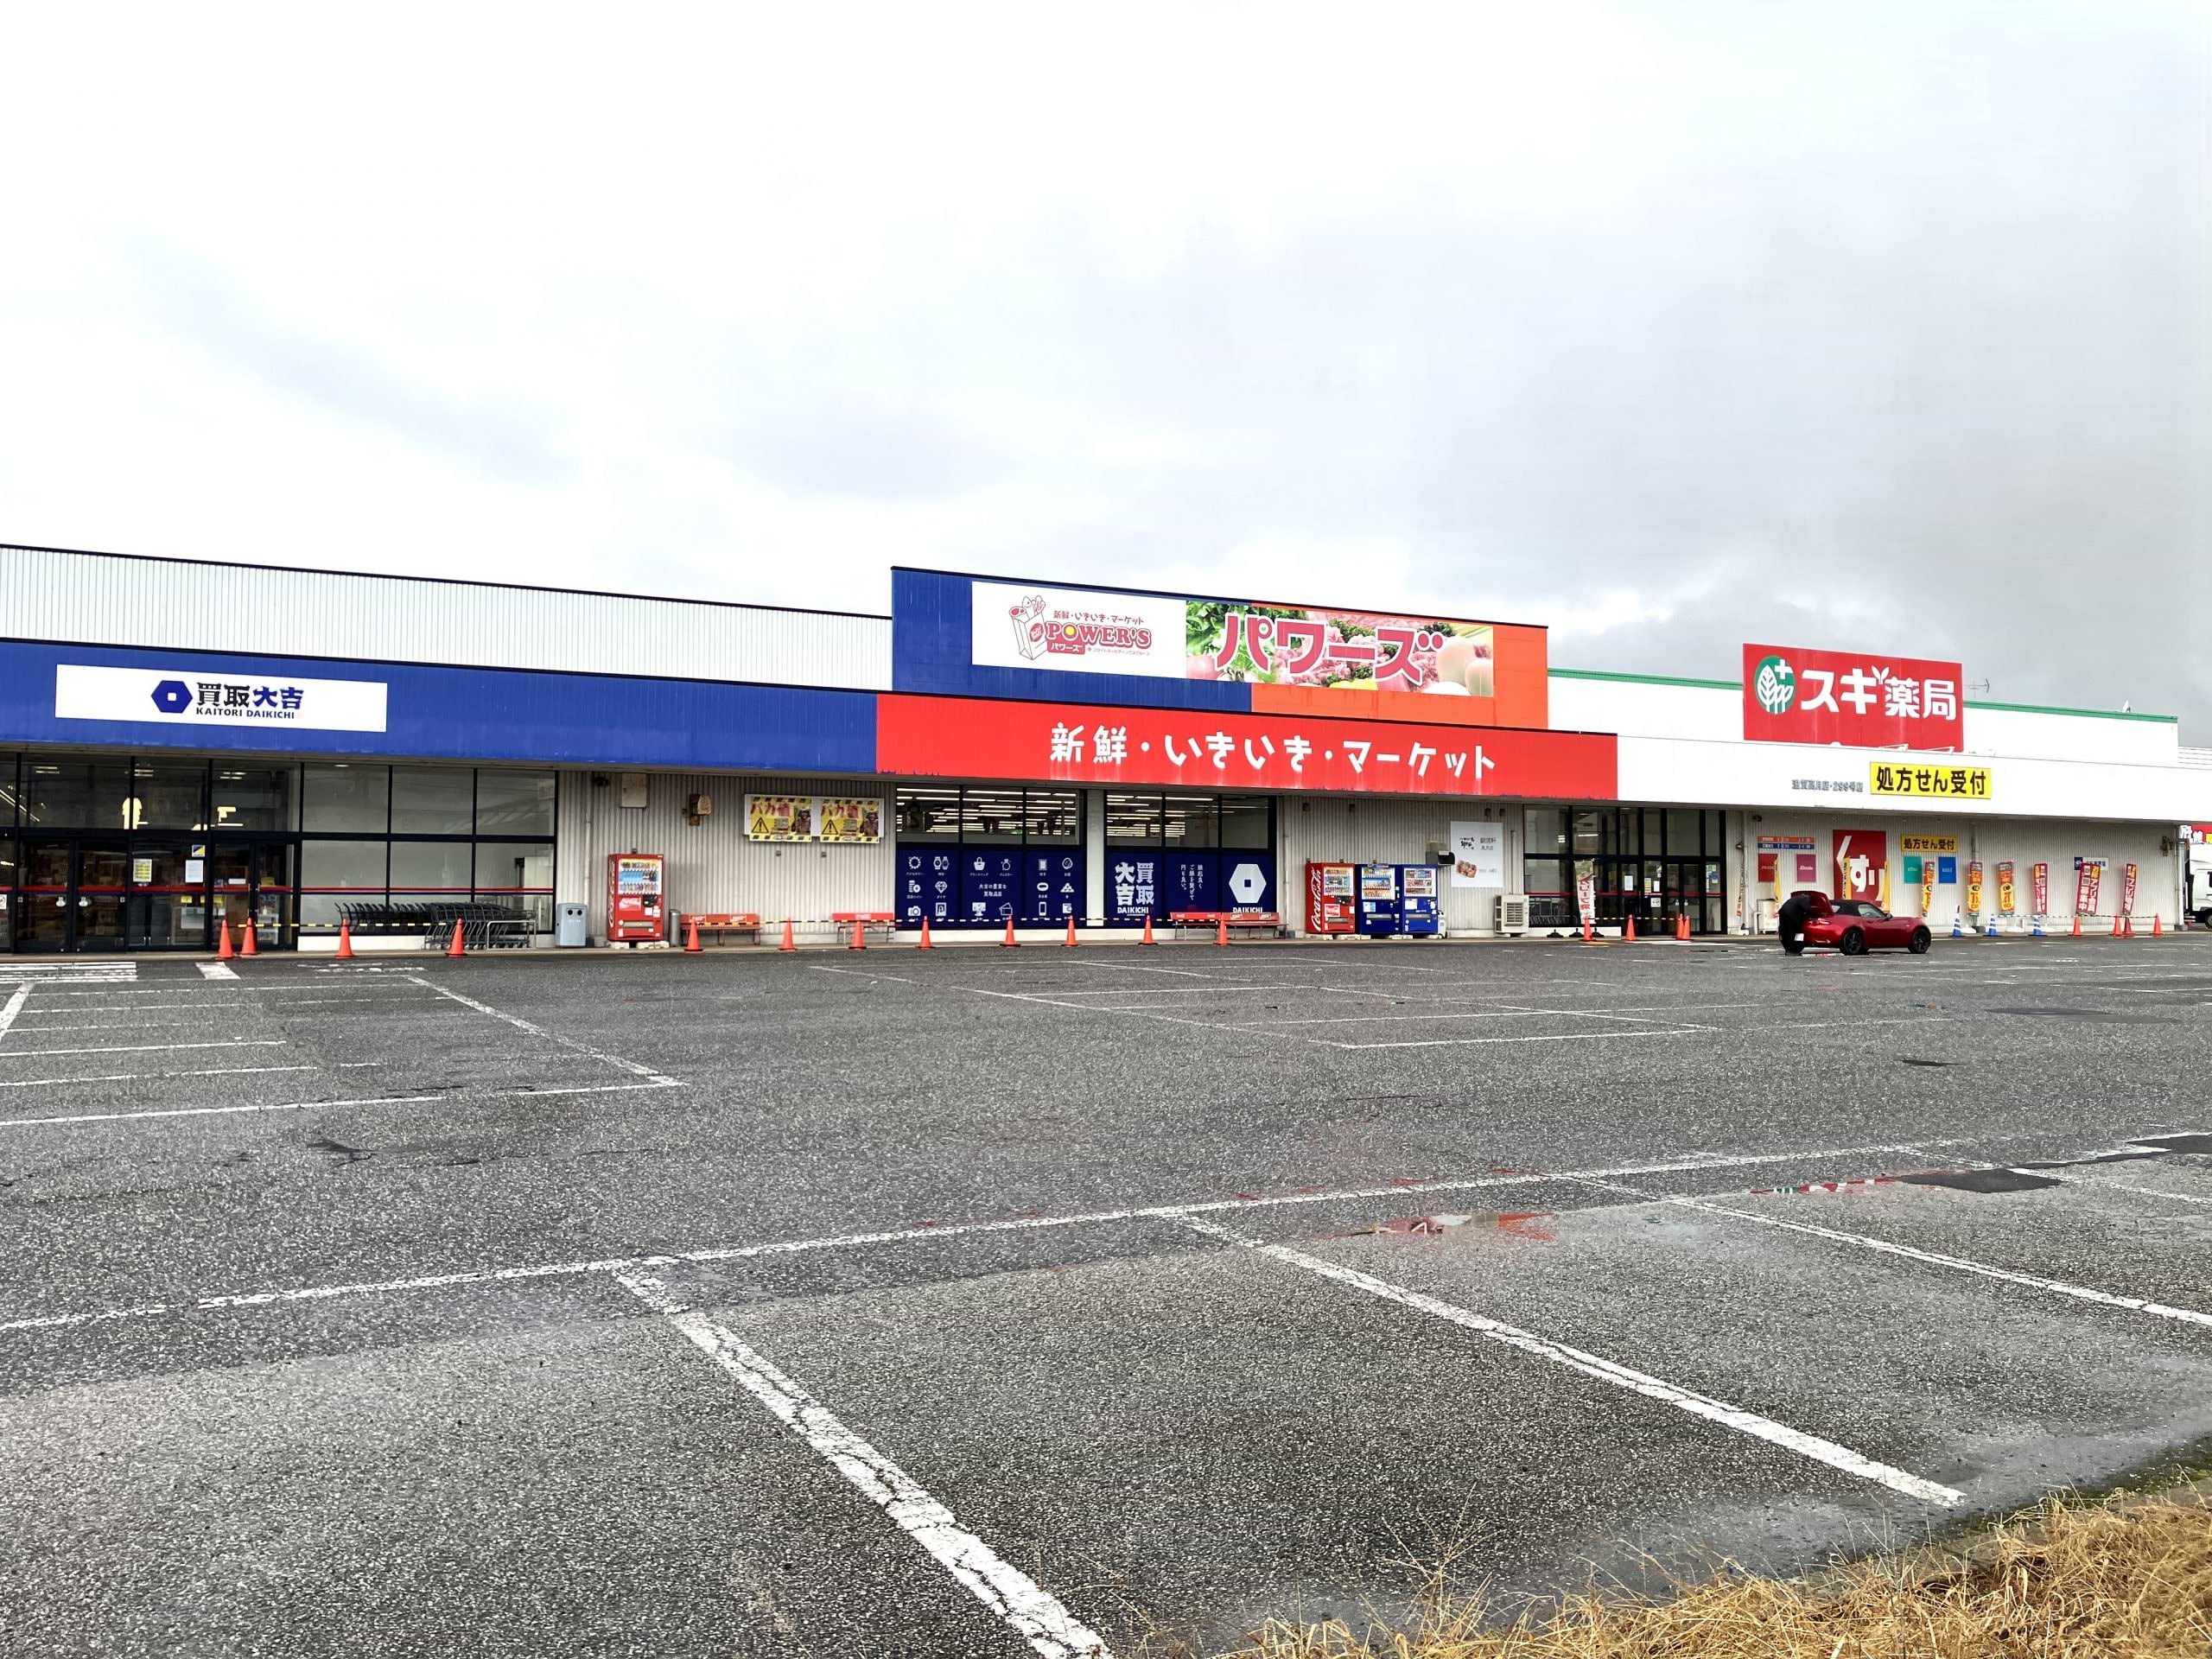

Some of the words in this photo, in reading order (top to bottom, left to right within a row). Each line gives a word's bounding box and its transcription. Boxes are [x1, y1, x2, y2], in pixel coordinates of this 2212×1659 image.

[1046, 621, 1151, 648] POWER'S
[1053, 610, 1144, 626] 新鮮・いきいき・マーケット
[1051, 643, 1083, 652] パワーズ
[1213, 613, 1445, 686] パワーズ
[197, 682, 304, 709] 買取大吉
[1801, 664, 1956, 721] スギ薬局
[196, 707, 243, 716] KAITORI
[246, 709, 295, 719] DAIKICHI
[1049, 721, 1496, 779] 新鮮・いきいき・マーケット
[1877, 766, 1986, 796] 処方せん受付
[1904, 838, 1955, 850] 処方せん受付
[1115, 861, 1135, 906] 大吉
[1135, 861, 1154, 906] 買取
[1836, 836, 1885, 901] くすり
[1310, 866, 1322, 932] Coca-Cola
